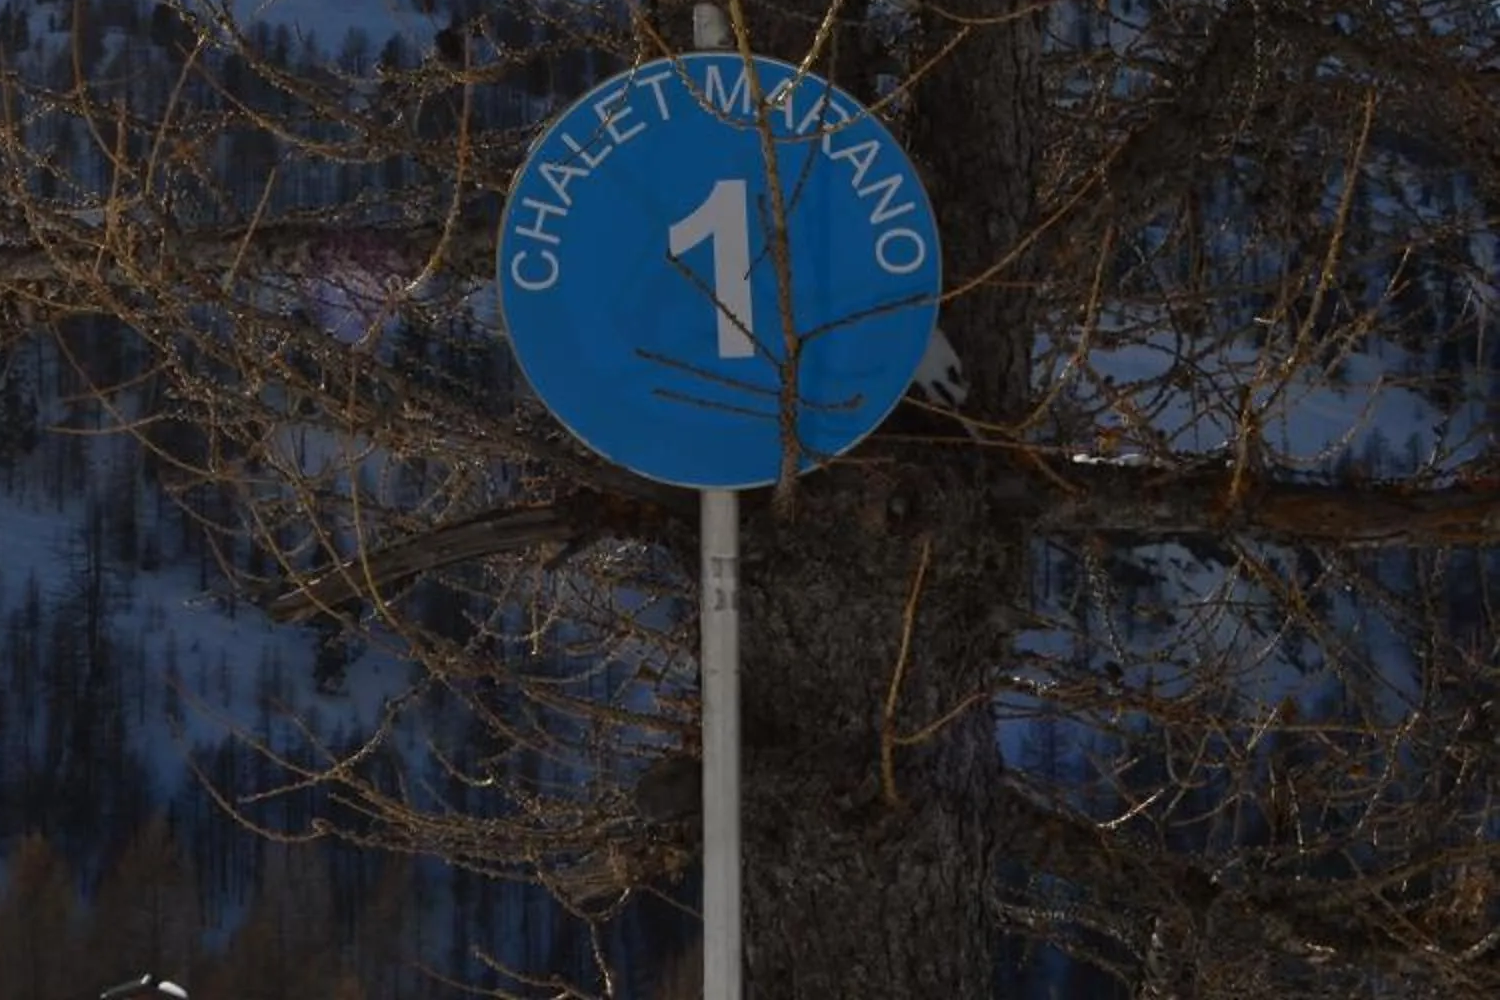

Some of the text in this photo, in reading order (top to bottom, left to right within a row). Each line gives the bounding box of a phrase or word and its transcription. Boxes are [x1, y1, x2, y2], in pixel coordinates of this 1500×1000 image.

[511, 65, 925, 290] CHALET MARANO
[669, 179, 754, 358] 1
